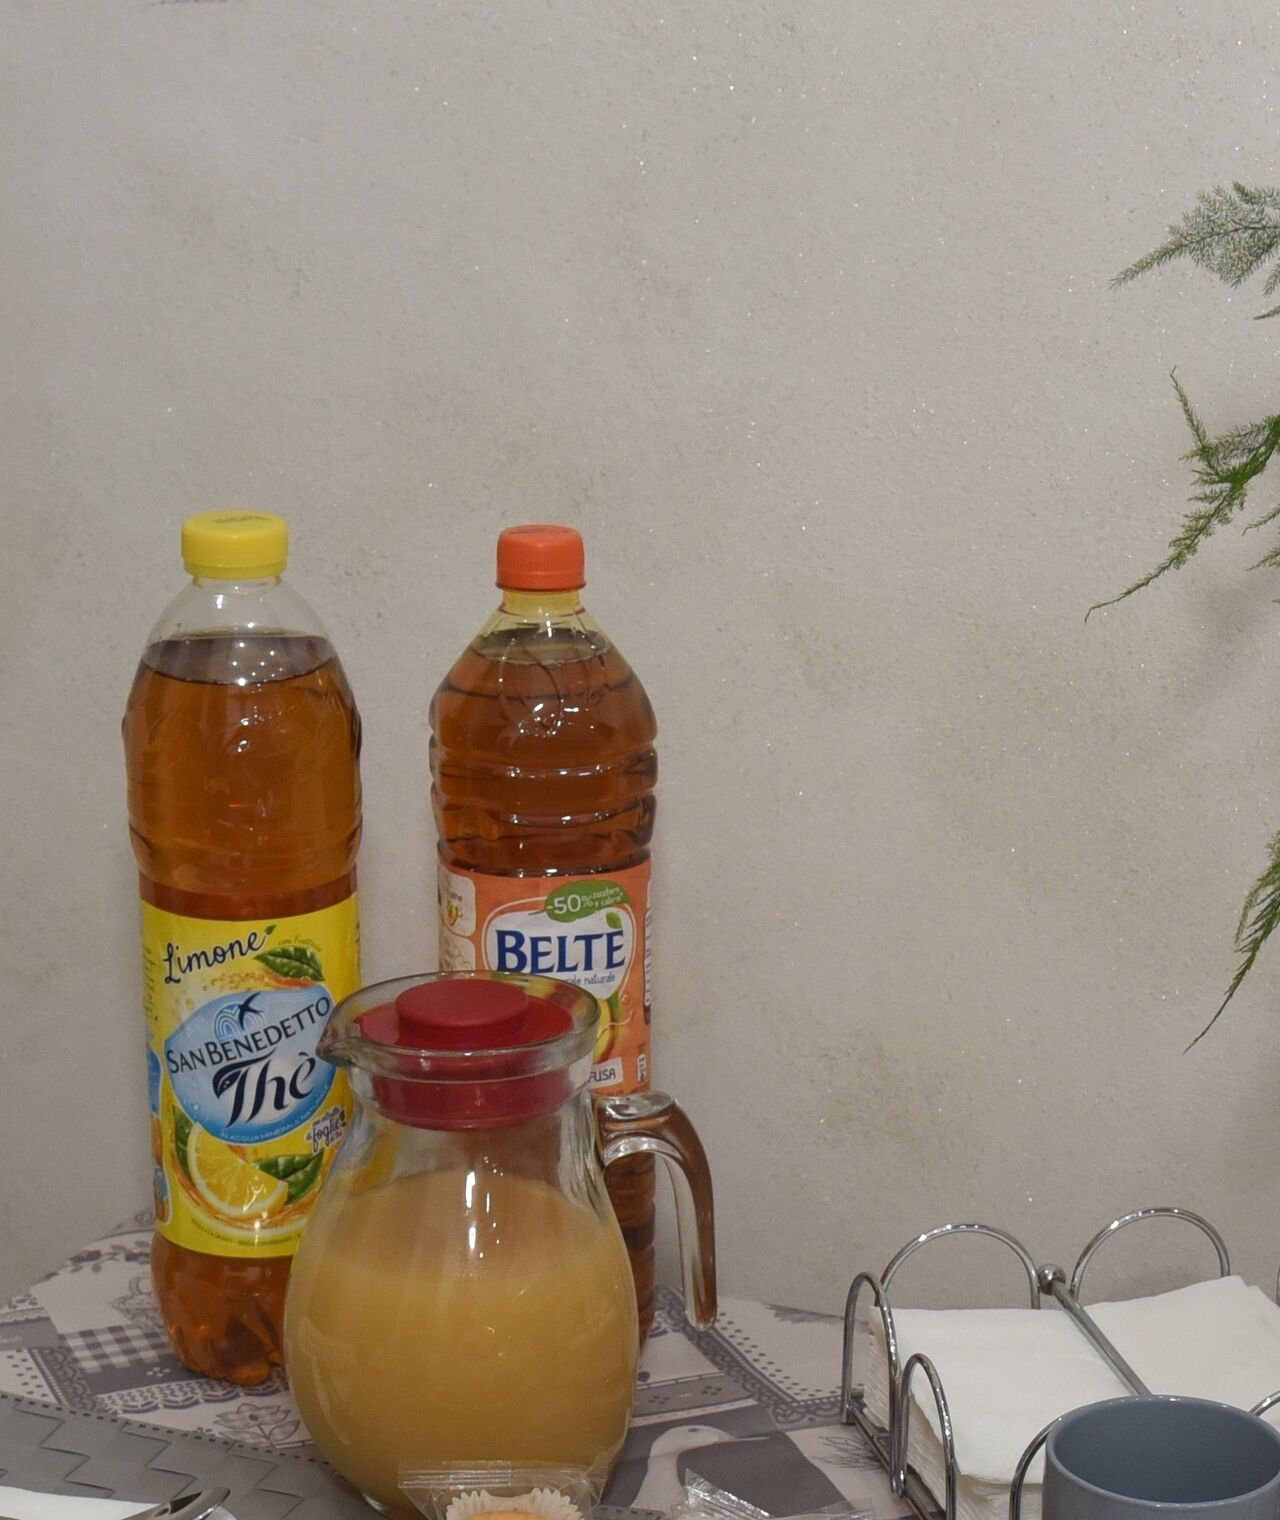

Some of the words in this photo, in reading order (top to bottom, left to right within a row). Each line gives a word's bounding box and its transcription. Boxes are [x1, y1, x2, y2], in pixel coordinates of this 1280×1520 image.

[546, 894, 593, 915] -50%
[162, 931, 267, 984] Limone
[584, 972, 615, 985] naturale
[166, 1047, 207, 1075] SAN
[205, 996, 332, 1066] BENEDETTO
[212, 1048, 317, 1129] Thè
[587, 1067, 616, 1083] FUSA
